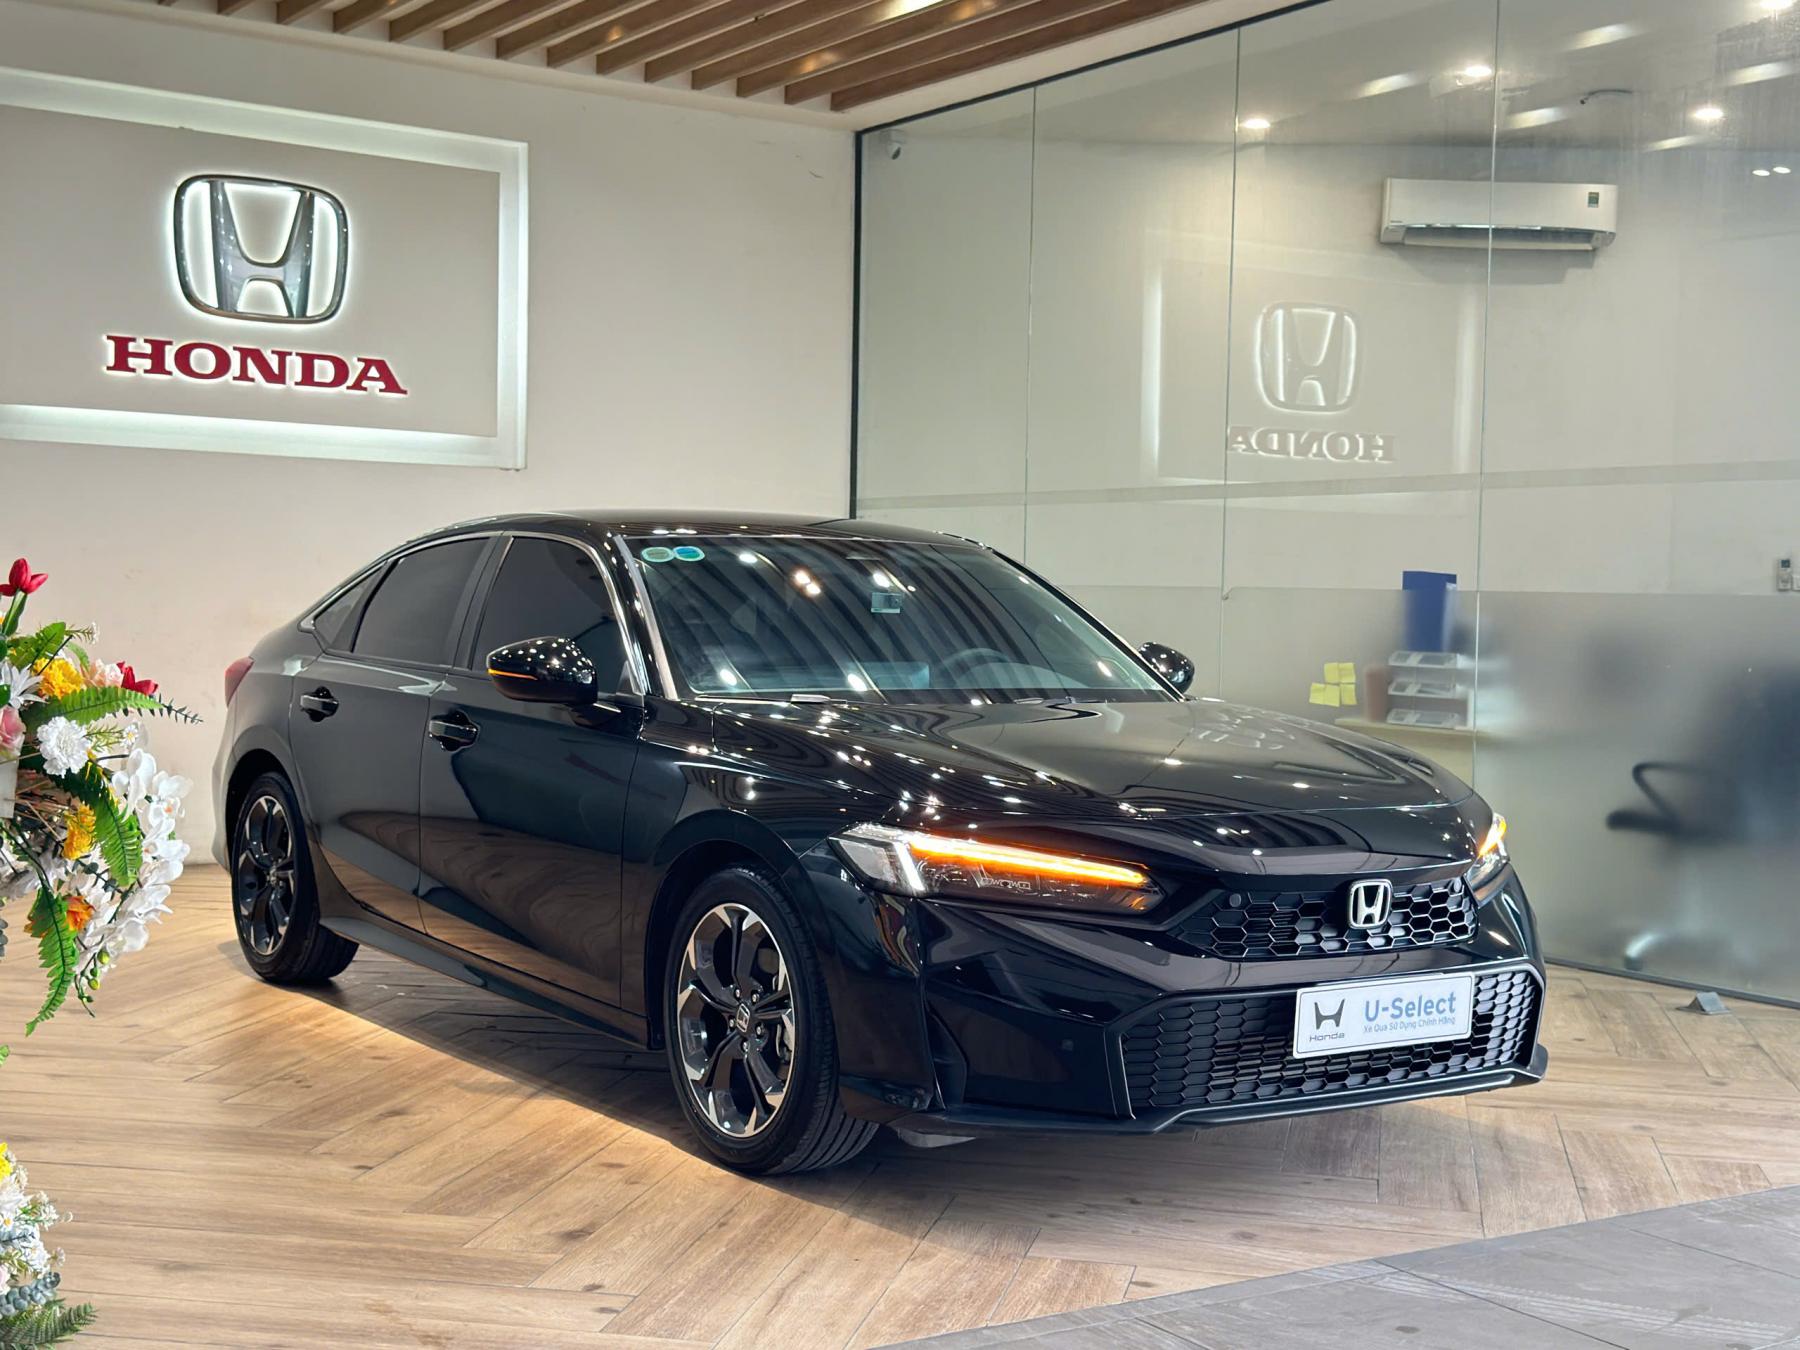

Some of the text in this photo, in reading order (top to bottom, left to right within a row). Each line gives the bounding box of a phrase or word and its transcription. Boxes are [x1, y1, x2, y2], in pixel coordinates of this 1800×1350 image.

[106, 334, 408, 395] HONDA
[1364, 991, 1457, 1022] U-Select
[1309, 1032, 1345, 1042] Honda
[1363, 1025, 1373, 1033] Xe
